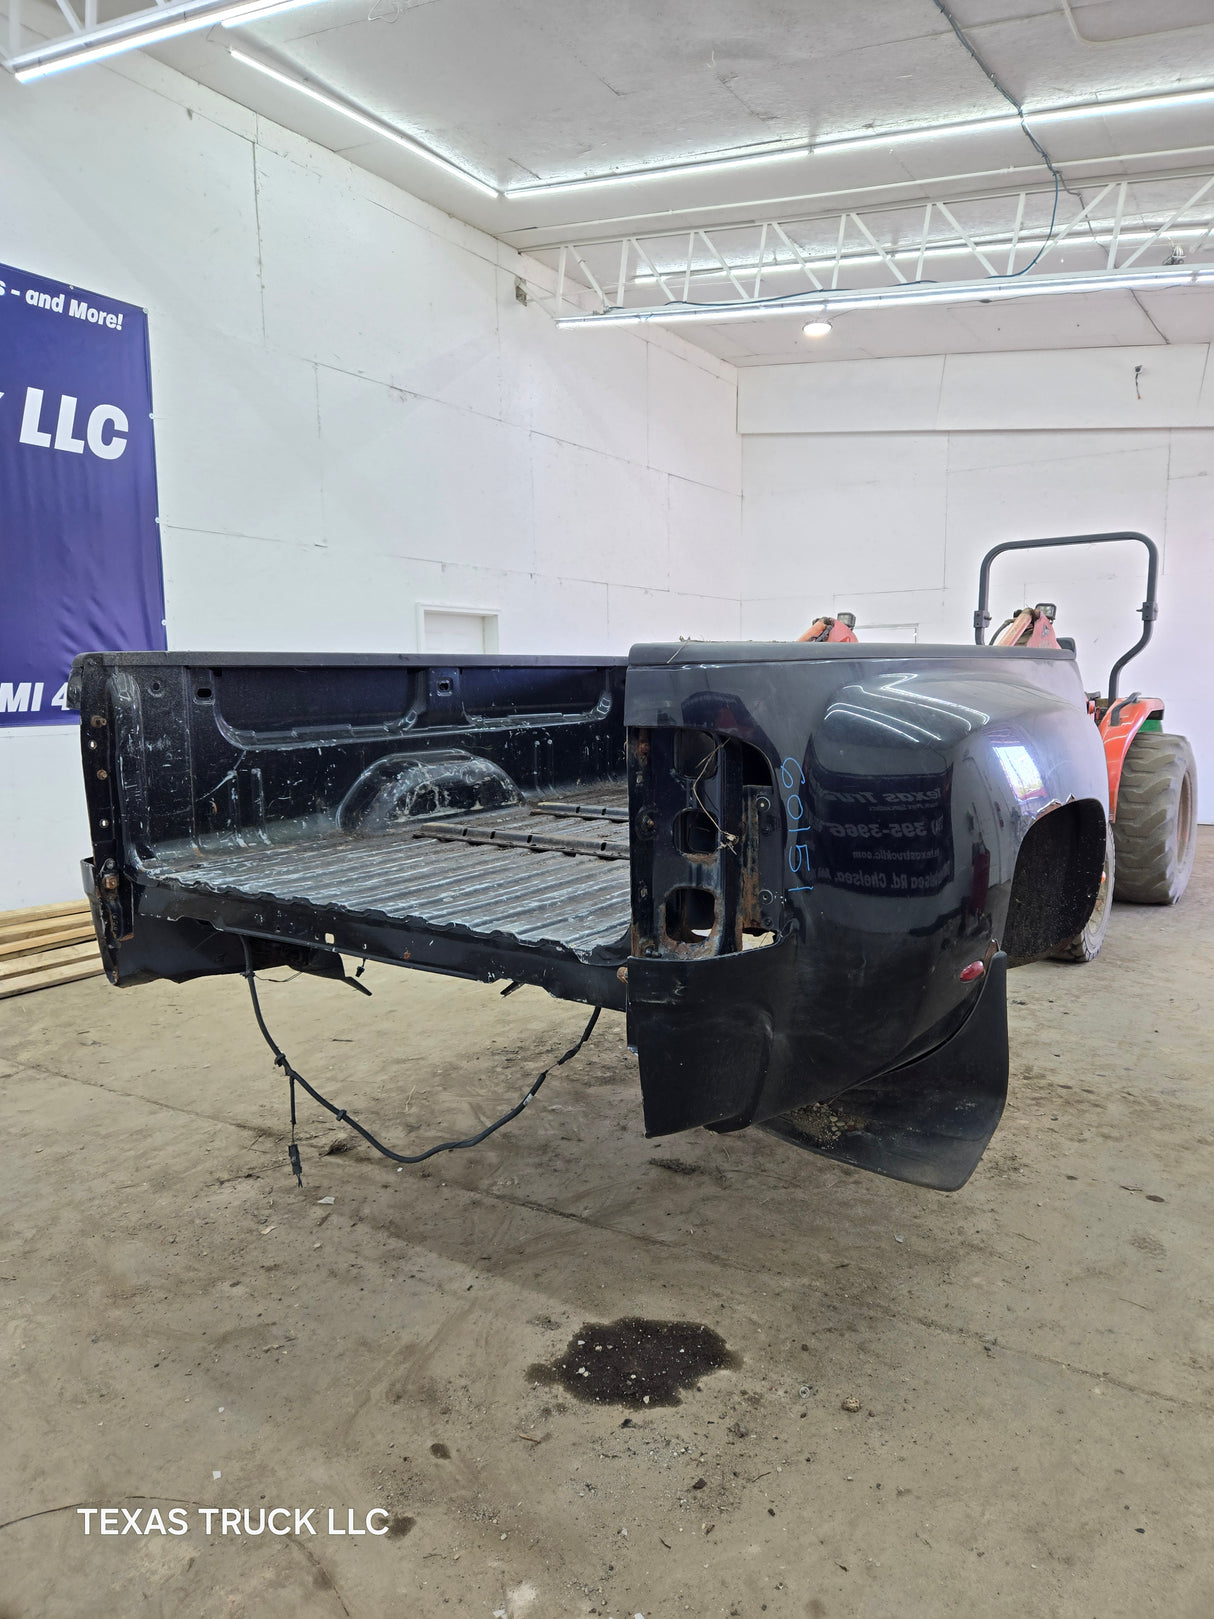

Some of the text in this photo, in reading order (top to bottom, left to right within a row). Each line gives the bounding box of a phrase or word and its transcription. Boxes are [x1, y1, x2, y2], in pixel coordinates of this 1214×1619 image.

[25, 289, 66, 313] and
[68, 299, 124, 331] More!
[19, 386, 129, 460] LLC
[0, 682, 45, 713] MI
[780, 757, 814, 892] 60151
